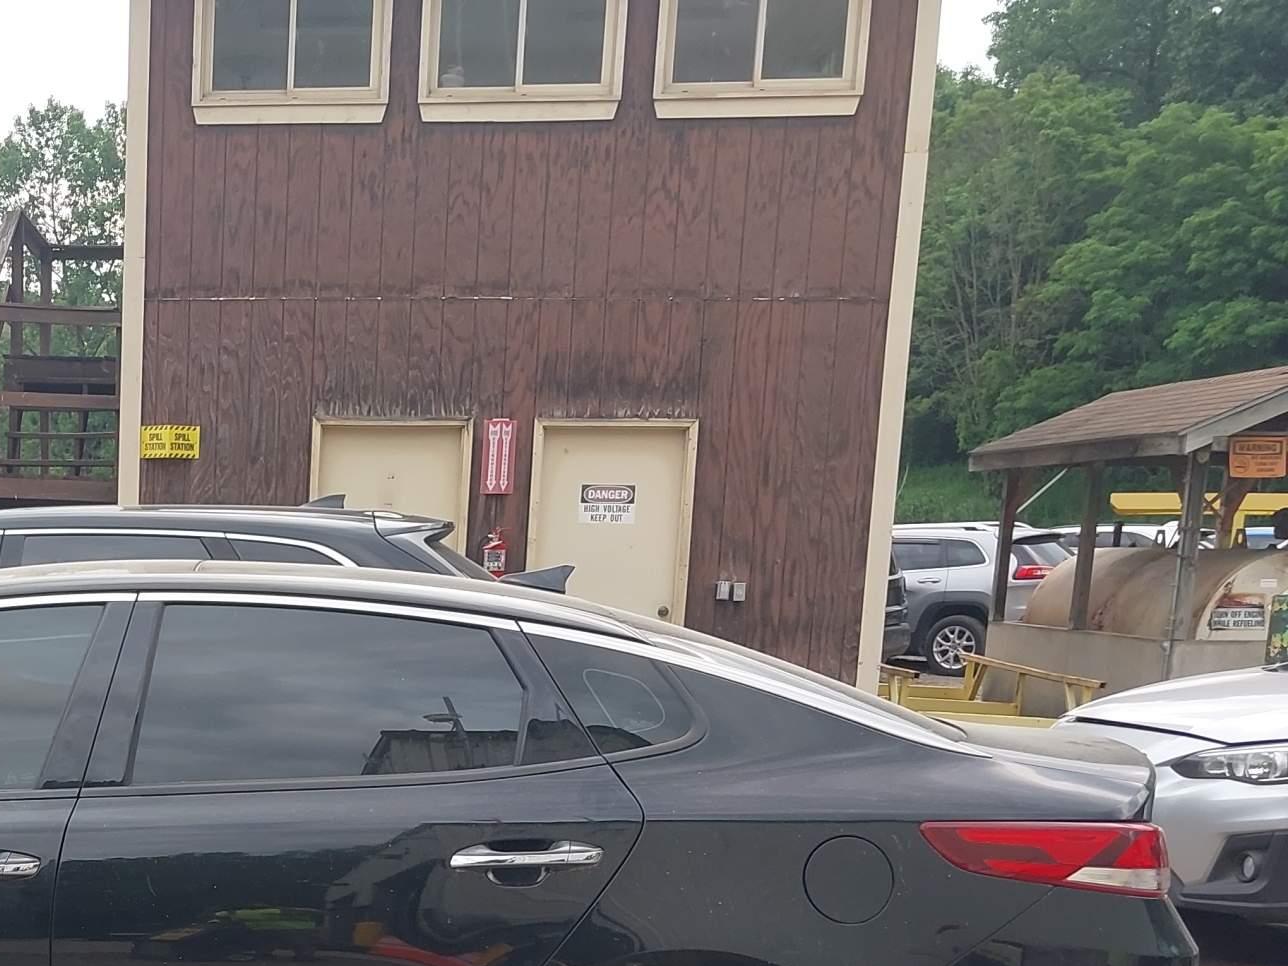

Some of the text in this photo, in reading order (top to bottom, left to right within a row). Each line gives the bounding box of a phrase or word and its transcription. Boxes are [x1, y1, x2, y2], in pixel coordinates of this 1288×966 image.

[148, 432, 163, 441] SPILL
[174, 432, 190, 442] SPILL
[144, 442, 166, 451] STATION
[170, 442, 195, 451] STATION
[588, 489, 628, 500] DANGER
[583, 504, 631, 513] HIGH VOLTAGE
[590, 513, 623, 522] KEEP OUT
[1230, 610, 1242, 619] OFF
